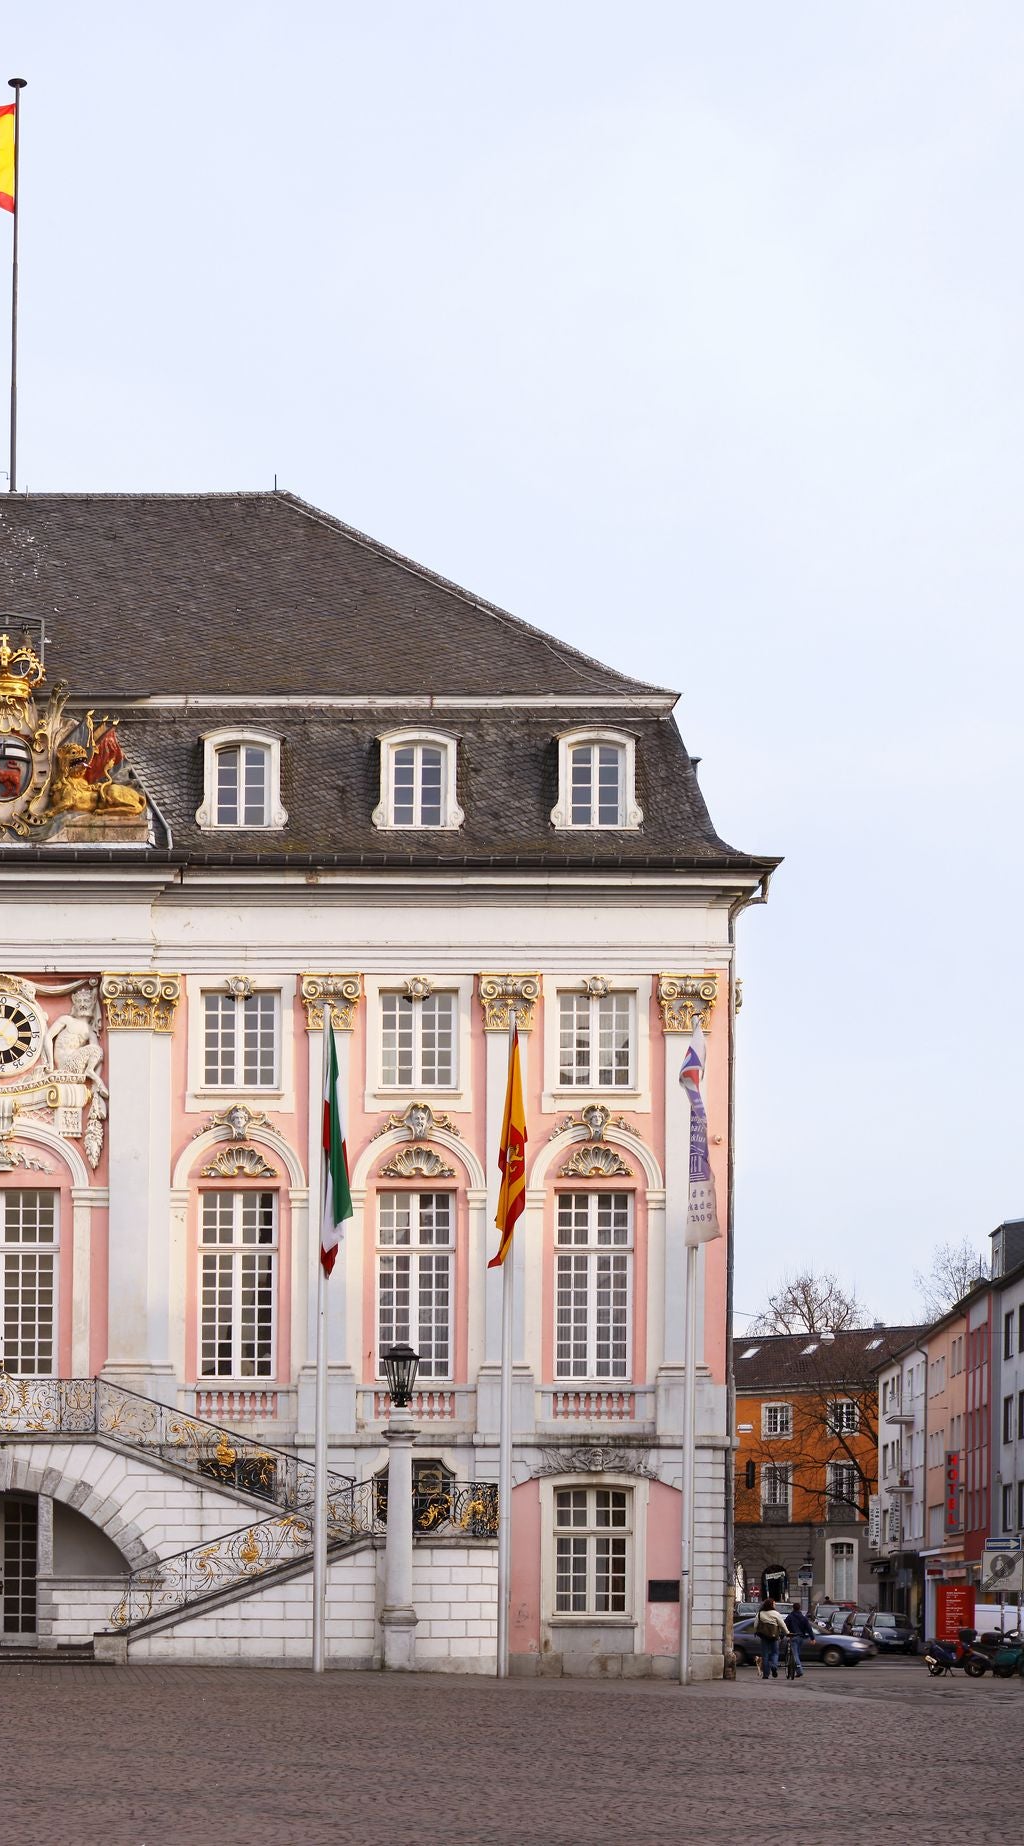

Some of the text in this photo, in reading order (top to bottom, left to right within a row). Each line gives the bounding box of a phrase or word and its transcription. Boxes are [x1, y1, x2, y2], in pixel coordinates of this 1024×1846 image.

[27, 1012, 36, 1022] 10
[26, 1046, 36, 1058] 20
[12, 1060, 24, 1068] 25
[692, 1189, 712, 1198] der
[688, 1201, 712, 1211] kade
[947, 1454, 959, 1526] HOTEL
